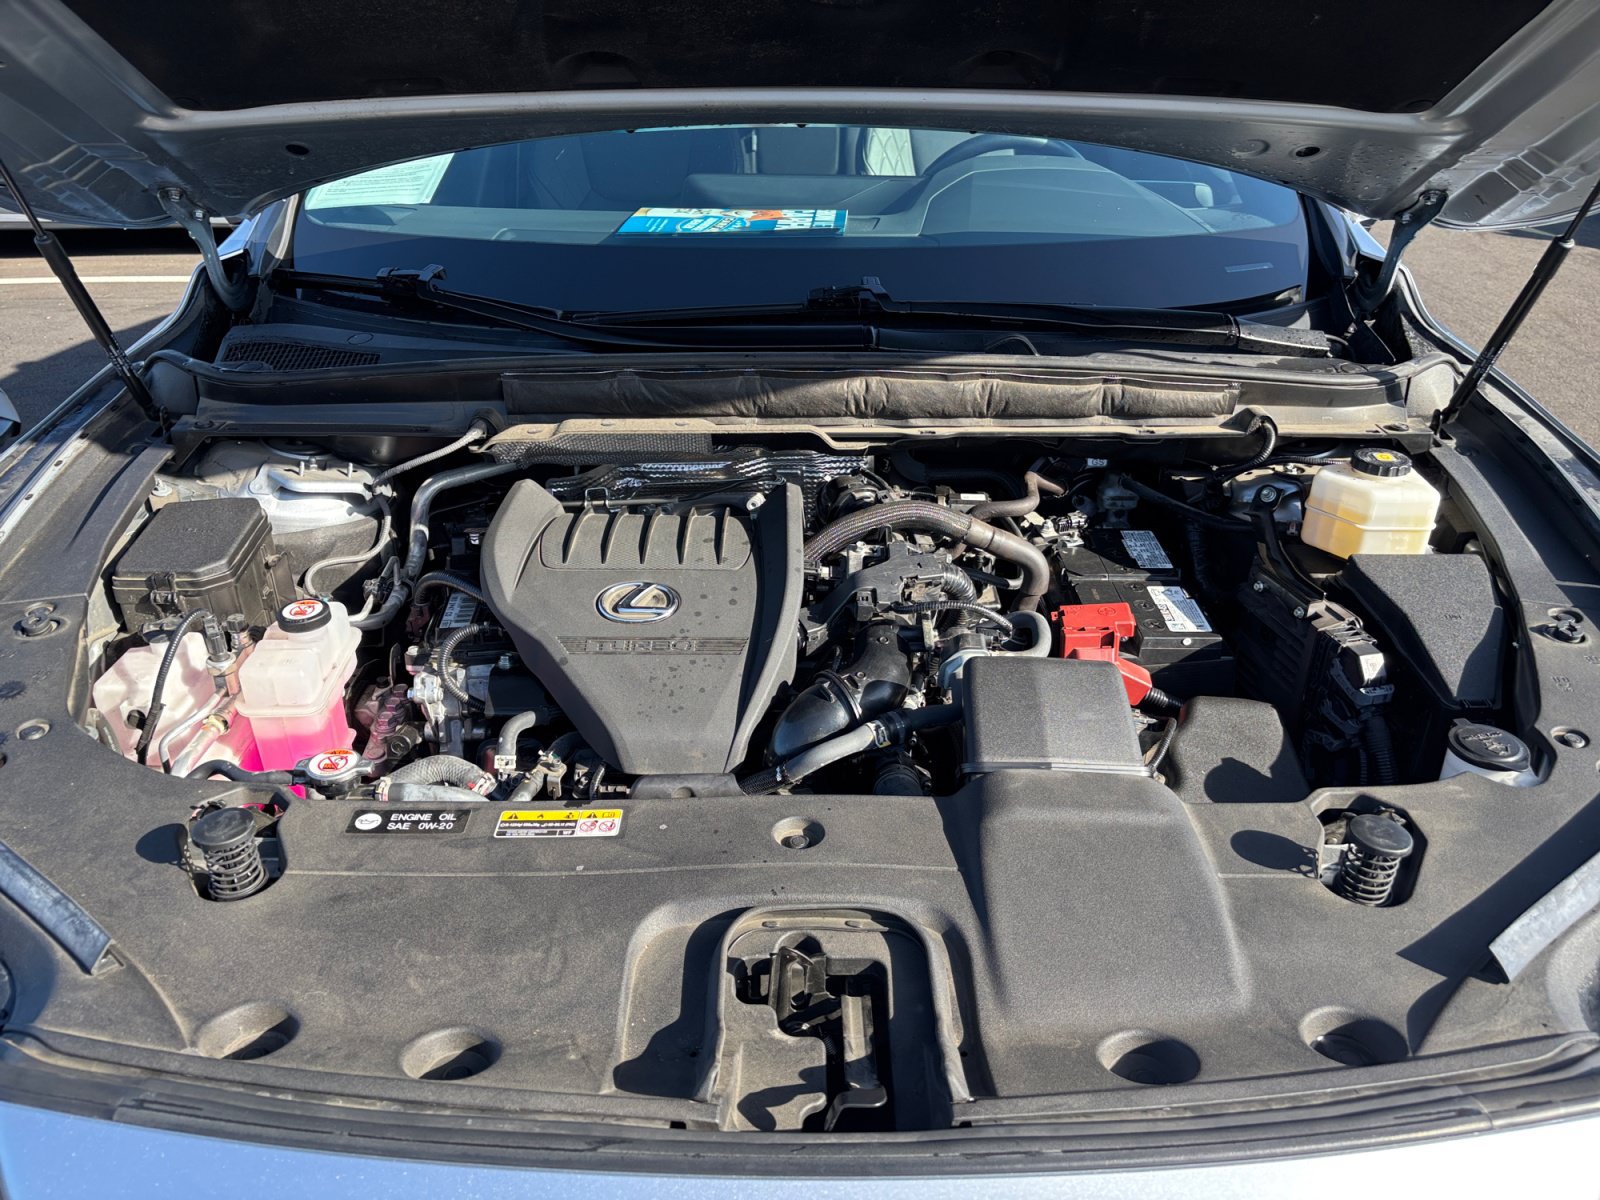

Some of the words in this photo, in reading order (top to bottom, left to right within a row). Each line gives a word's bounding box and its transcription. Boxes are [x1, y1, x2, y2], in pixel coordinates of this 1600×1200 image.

[586, 639, 692, 652] TURBO
[390, 813, 433, 821] ENGINE
[438, 813, 457, 821] OIL
[386, 822, 411, 830] SAE
[418, 822, 454, 830] 0W-20
